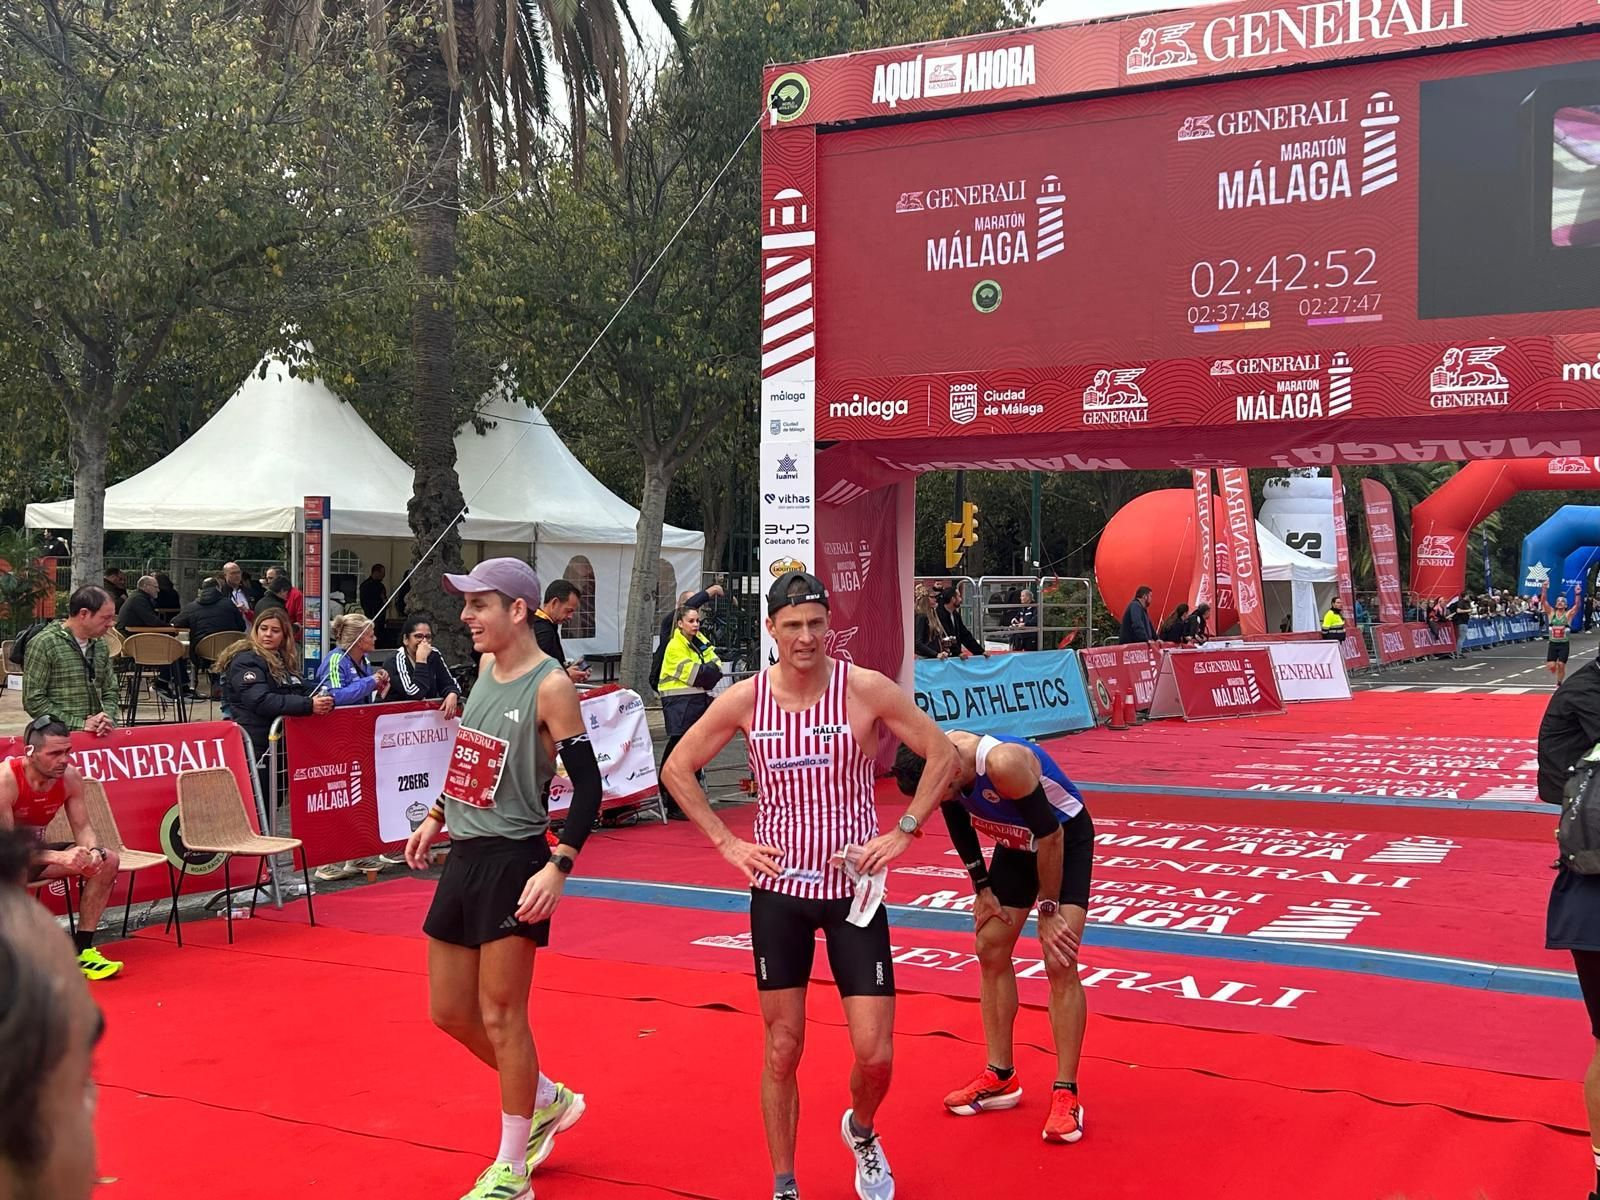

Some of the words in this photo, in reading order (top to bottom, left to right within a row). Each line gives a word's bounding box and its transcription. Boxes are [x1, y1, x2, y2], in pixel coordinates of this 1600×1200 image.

[1203, 0, 1468, 62] GENERALI
[963, 45, 1035, 93] AHORA
[872, 54, 923, 107] AQUÍ
[1217, 98, 1349, 136] GENERALI
[1280, 136, 1346, 161] MARATÓN
[926, 180, 1027, 210] GENERALI
[1218, 159, 1352, 210] MÁLAGA
[975, 211, 1025, 231] MARATÓN
[927, 230, 1029, 271] MÁLAGA
[1191, 248, 1378, 298] 02:42:52
[1187, 301, 1270, 323] 02:37:48
[1299, 294, 1382, 316] 02:27:47
[1235, 354, 1321, 375] GENERALI
[984, 388, 1025, 401] Ciudad
[1277, 378, 1319, 393] MARATÓN
[984, 403, 998, 416] de
[1001, 401, 1044, 416] Málaga
[1236, 390, 1323, 421] MÁLAGA
[1430, 391, 1509, 409] GENERALI
[1083, 409, 1149, 425] GENERALI
[778, 494, 810, 504] vithas
[764, 524, 810, 534] BYD
[309, 545, 315, 553] 5
[1417, 558, 1455, 566] GENERALI
[1205, 659, 1242, 672] GENERALI
[965, 677, 1069, 718] ATHLETICS
[1212, 684, 1252, 707] MÁLAGA
[397, 727, 449, 747] GENERALI
[456, 728, 497, 751] GENERALI
[454, 745, 480, 764] 355
[769, 757, 829, 769] uddevalla.se
[307, 763, 347, 779] GENERALI
[398, 772, 430, 792] 226ERS
[307, 789, 350, 813] MÁLAGA
[1127, 821, 1372, 841] GENERALI
[1222, 834, 1353, 849] MARATÓN
[1093, 832, 1345, 861] MÁLAGA
[1090, 878, 1274, 906] ERALI
[1088, 894, 1244, 916] MARATÓN
[760, 956, 768, 981] FUSION
[876, 961, 884, 986] FUSION
